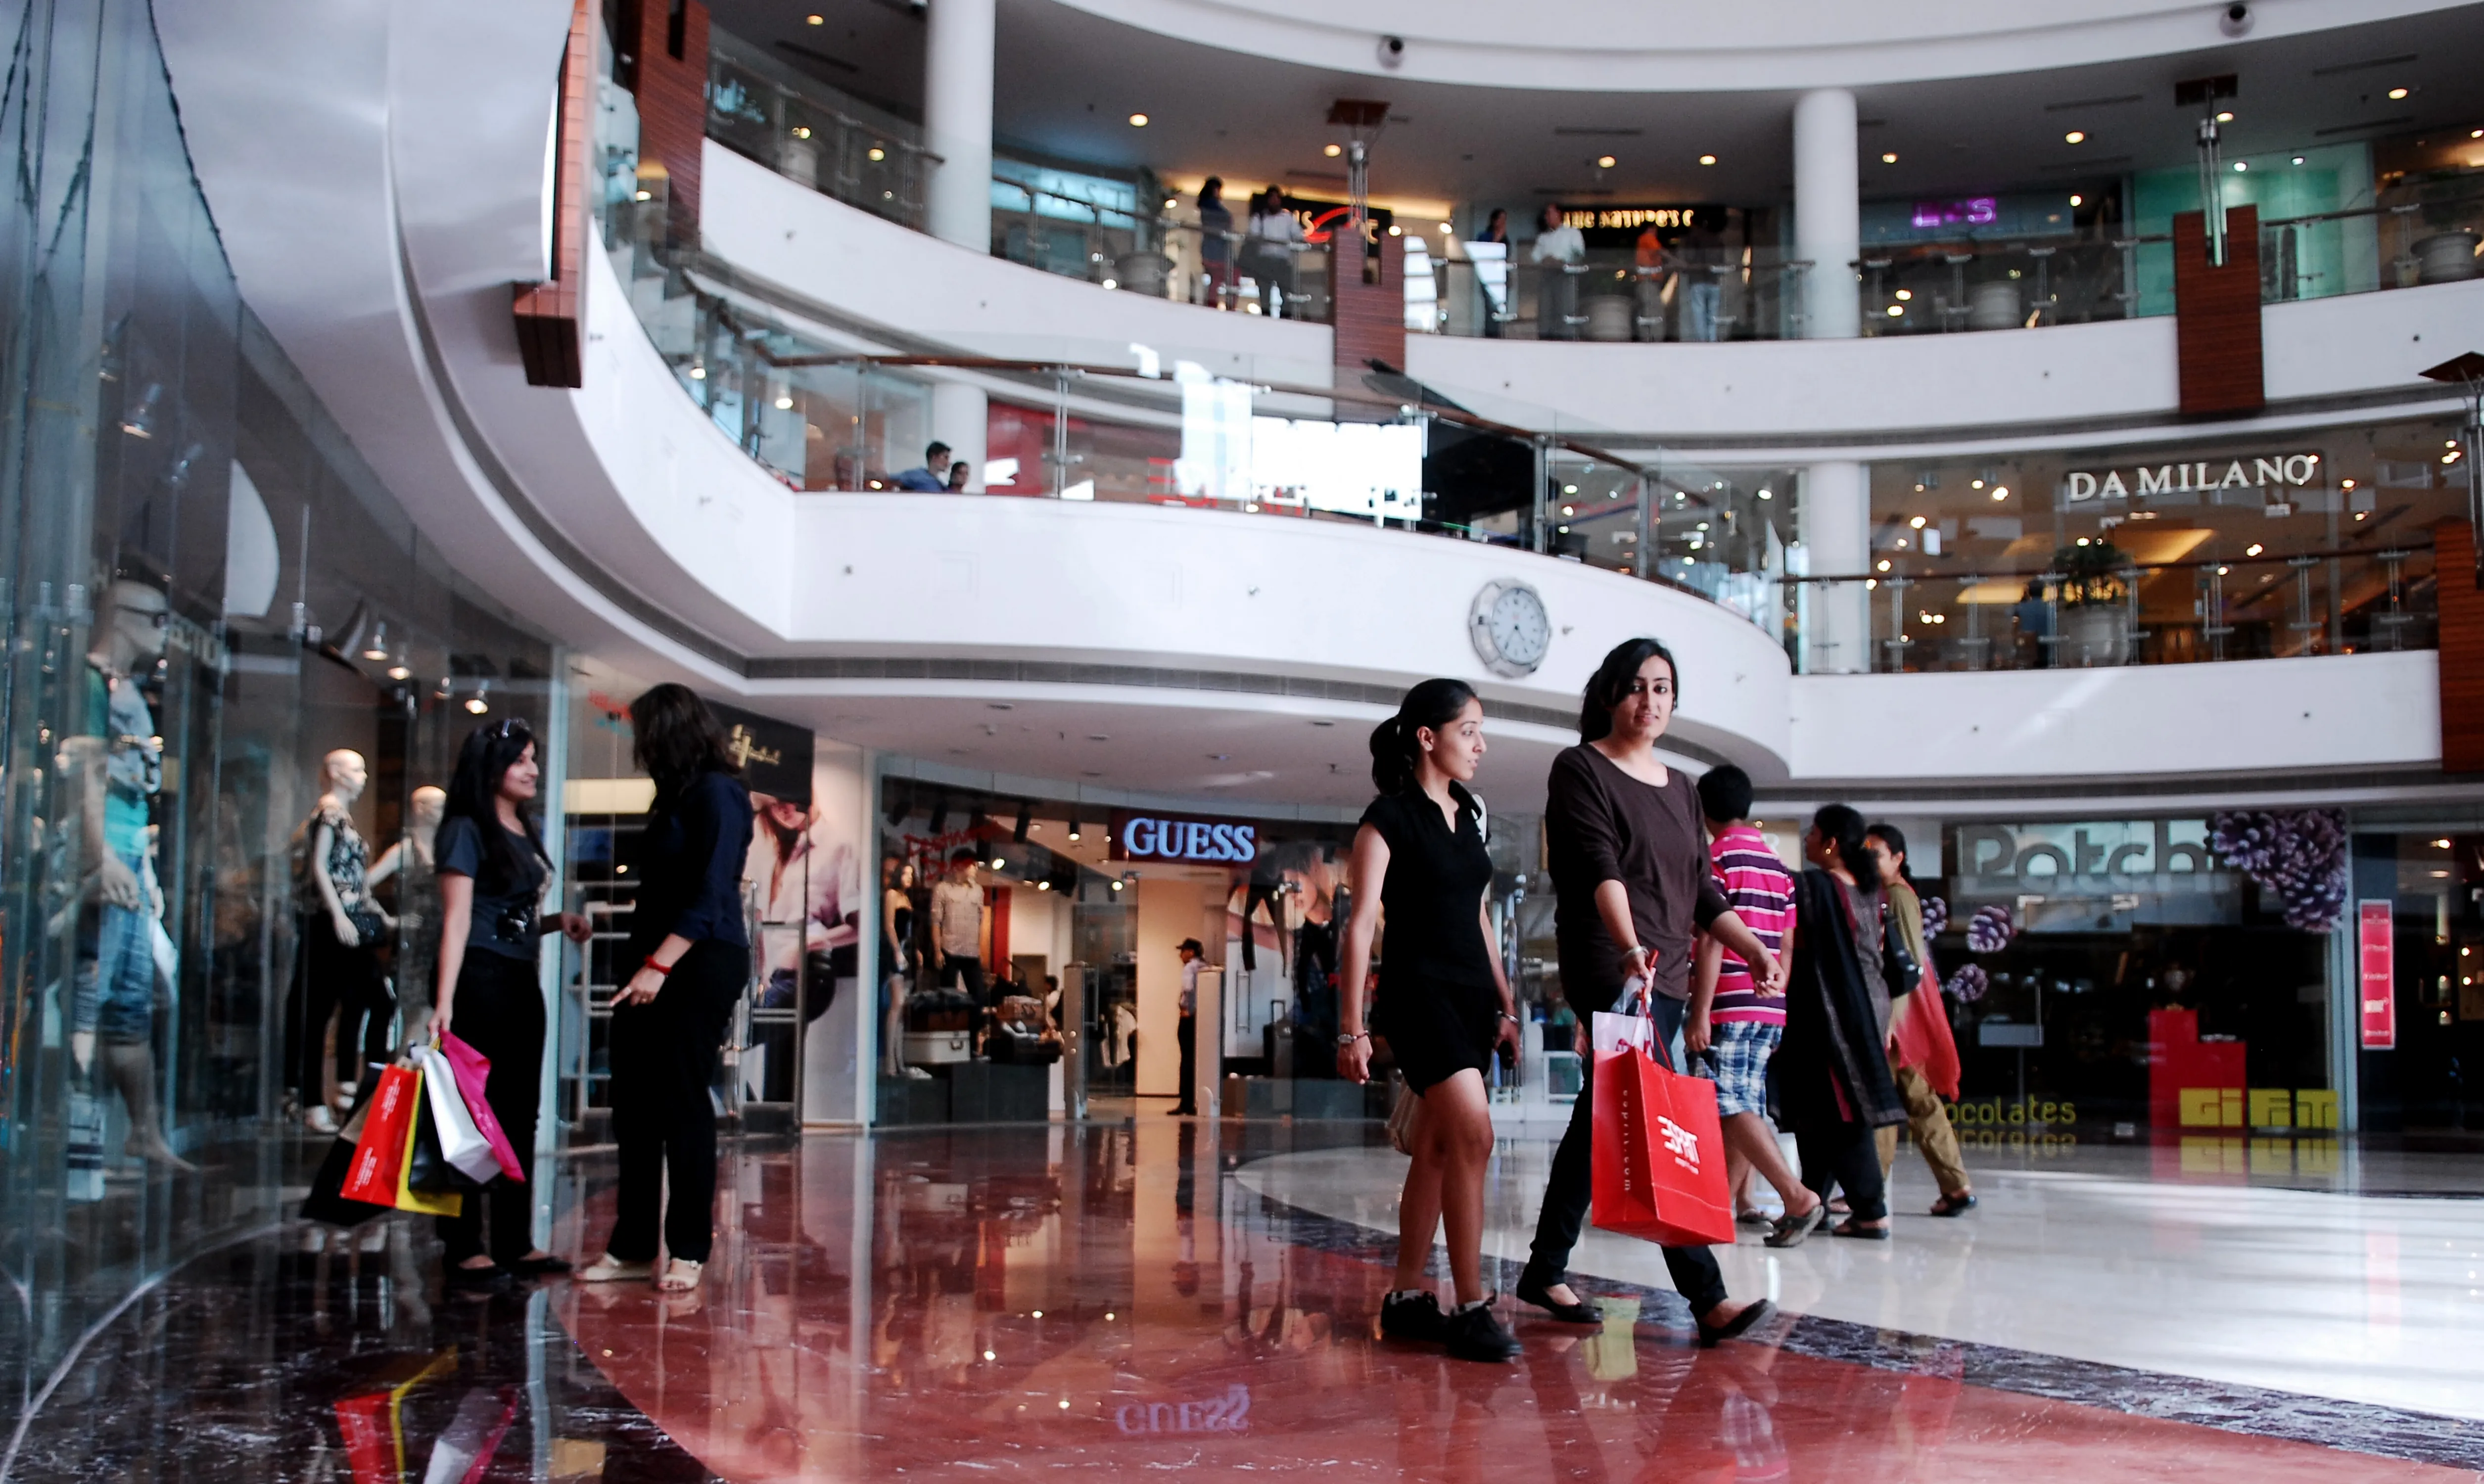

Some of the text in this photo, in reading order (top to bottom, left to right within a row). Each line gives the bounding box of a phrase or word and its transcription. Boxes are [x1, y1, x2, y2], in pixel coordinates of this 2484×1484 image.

[2068, 454, 2315, 503] DA MILANO
[1124, 817, 1255, 862] GUESS
[1944, 1093, 2077, 1126] ocolates
